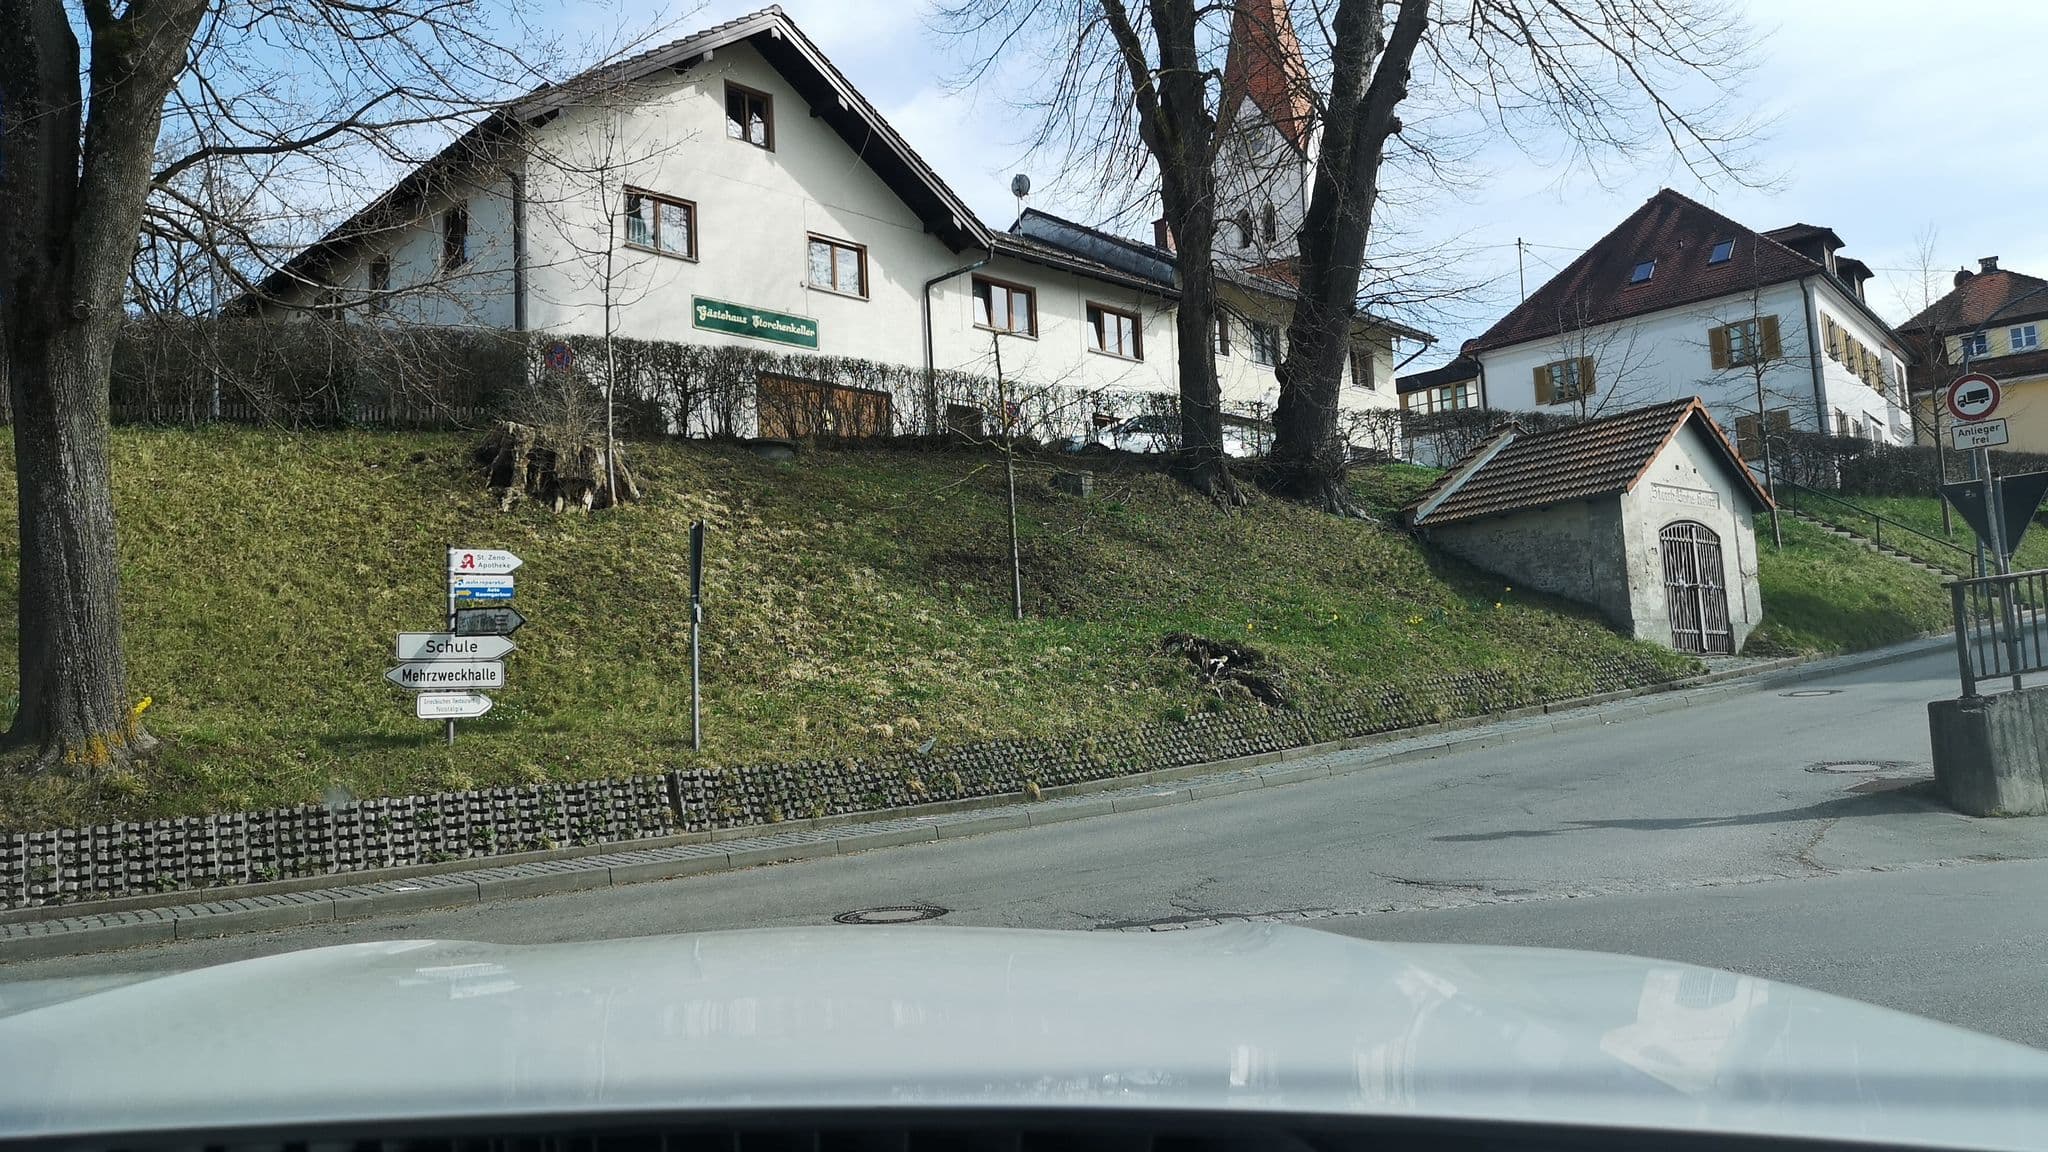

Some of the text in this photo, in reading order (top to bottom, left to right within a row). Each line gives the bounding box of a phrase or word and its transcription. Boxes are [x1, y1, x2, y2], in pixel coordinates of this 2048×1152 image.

[696, 305, 815, 337] Gästehaus Storchenkeller
[1958, 424, 2001, 438] Anlieger
[1972, 436, 1989, 445] frei
[426, 639, 478, 653] Schule
[402, 668, 496, 682] Mehrzweckhalle
